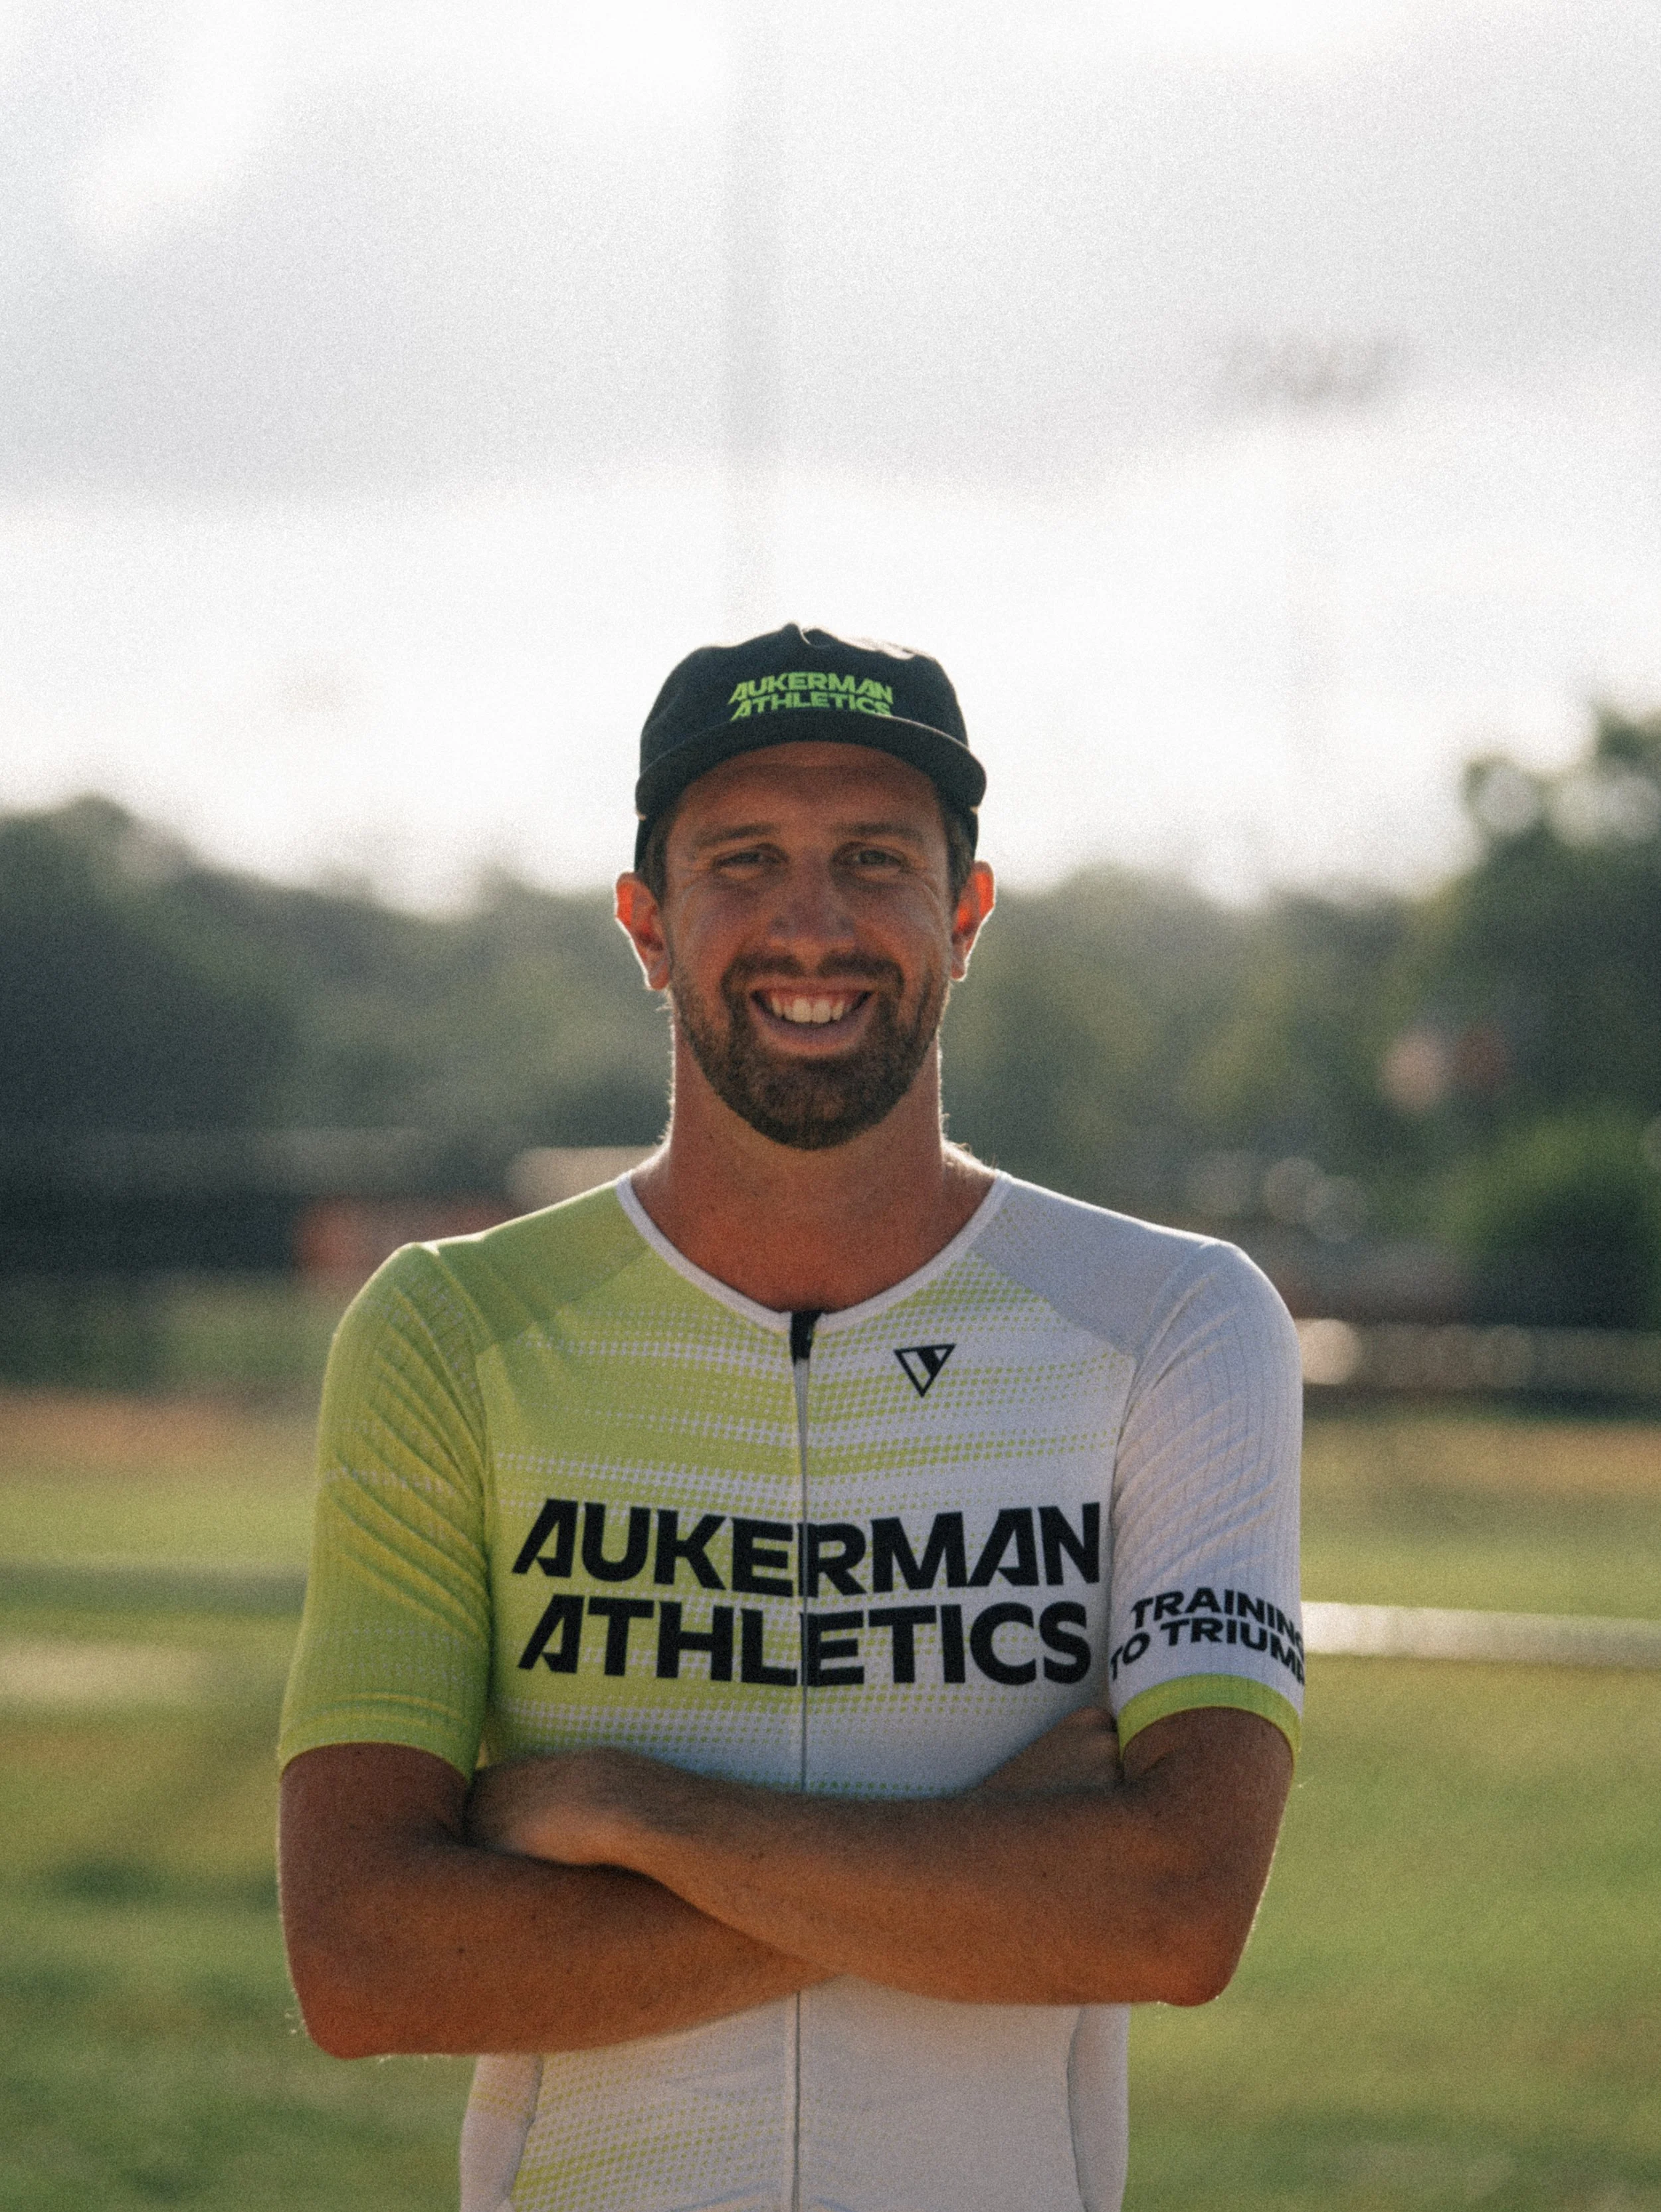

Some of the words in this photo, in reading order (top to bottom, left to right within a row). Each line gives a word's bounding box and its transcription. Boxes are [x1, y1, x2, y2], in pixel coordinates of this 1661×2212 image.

[728, 671, 894, 705] AUKERMAN
[730, 691, 892, 721] ATHLETICS
[512, 1498, 1100, 1598] AUKERMAN
[518, 1594, 1092, 1687] ATHLETICS
[1110, 1631, 1151, 1681] TO
